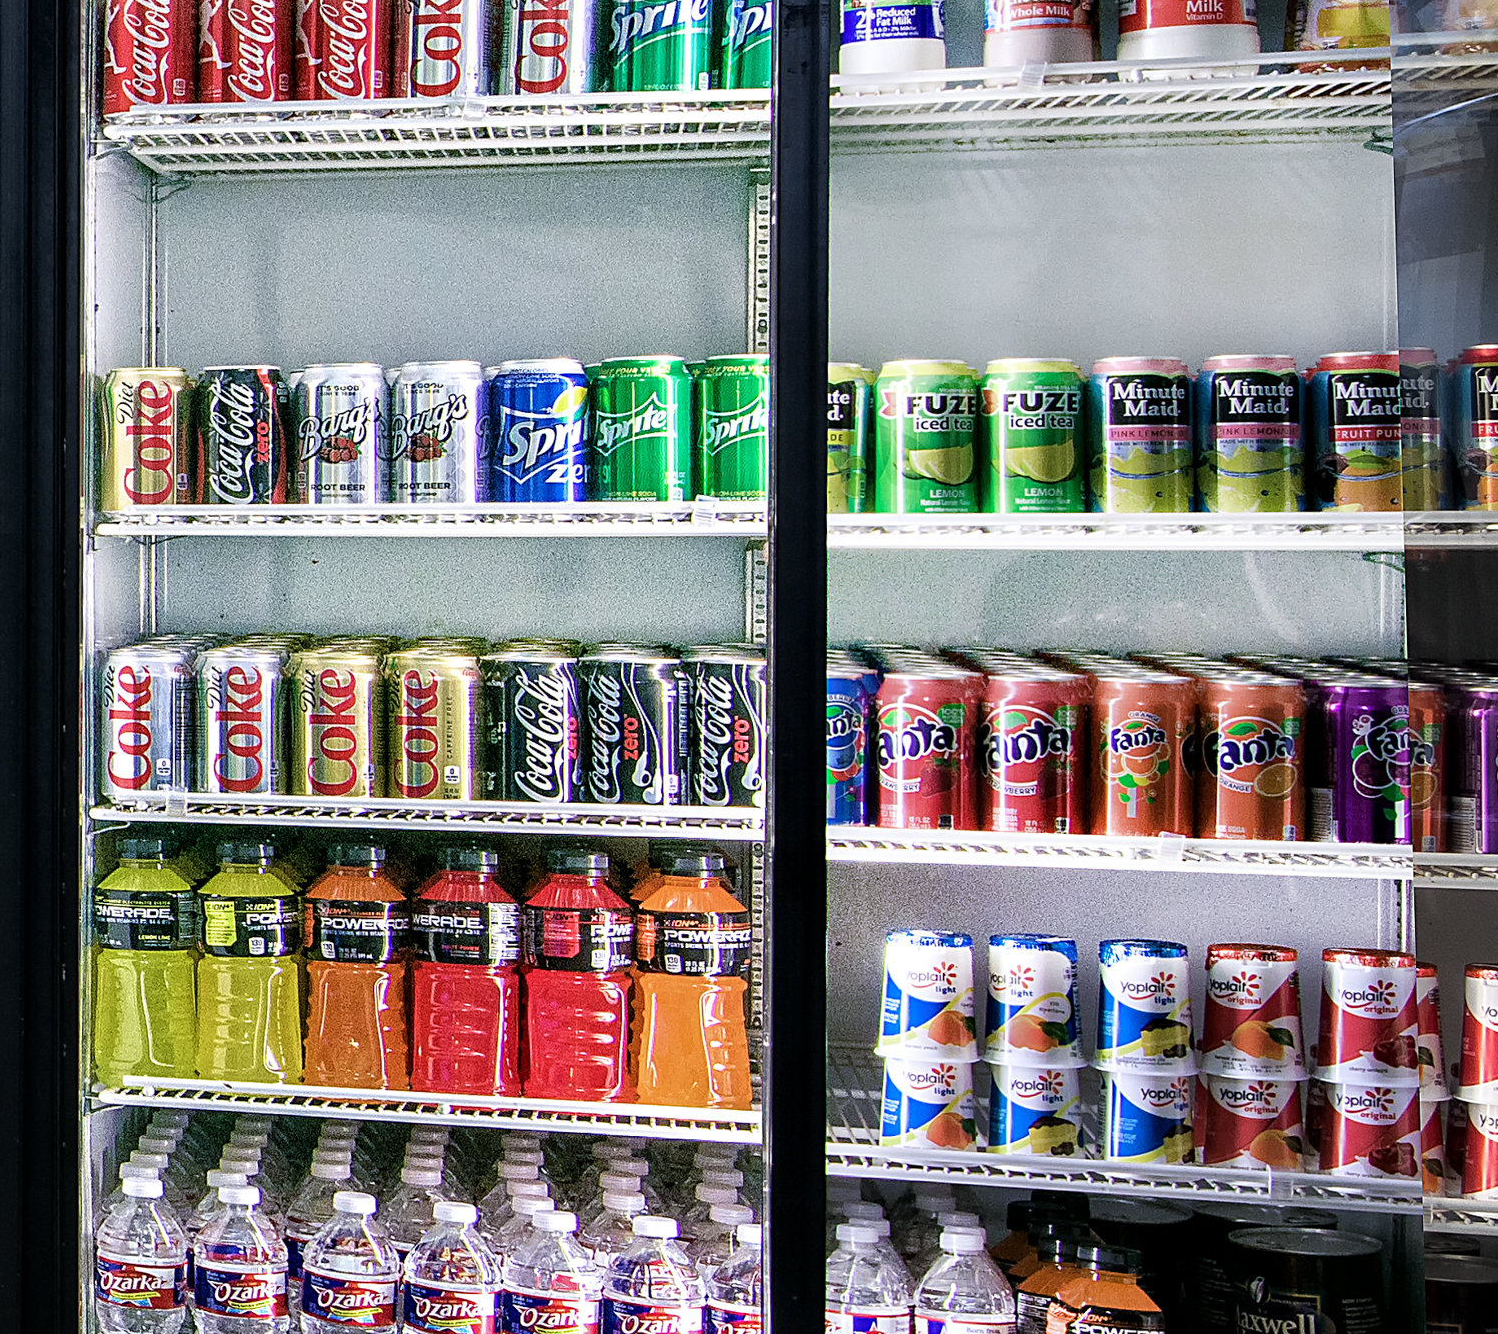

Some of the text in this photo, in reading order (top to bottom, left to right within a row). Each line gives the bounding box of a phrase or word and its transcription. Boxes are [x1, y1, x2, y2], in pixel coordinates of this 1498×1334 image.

[876, 7, 916, 16] Reduced
[876, 16, 912, 25] Fat Milk
[1113, 382, 1185, 401] Minute
[1218, 379, 1294, 399] Minute
[906, 394, 977, 415] FUZE
[1004, 392, 1079, 413] FUZE
[915, 417, 973, 431] iced tea
[1009, 415, 1074, 428] iced tea
[124, 379, 173, 504] Coke
[108, 665, 152, 790] Coke
[624, 716, 639, 760] zero
[734, 717, 750, 763] zero
[1110, 726, 1166, 753] Fanta
[1120, 979, 1165, 995] Yoplait
[1227, 996, 1262, 1005] original
[1364, 1004, 1399, 1014] original
[1011, 1077, 1053, 1093] Yoplait
[99, 1271, 168, 1292] Ozarka
[315, 1285, 388, 1308] Ozarka
